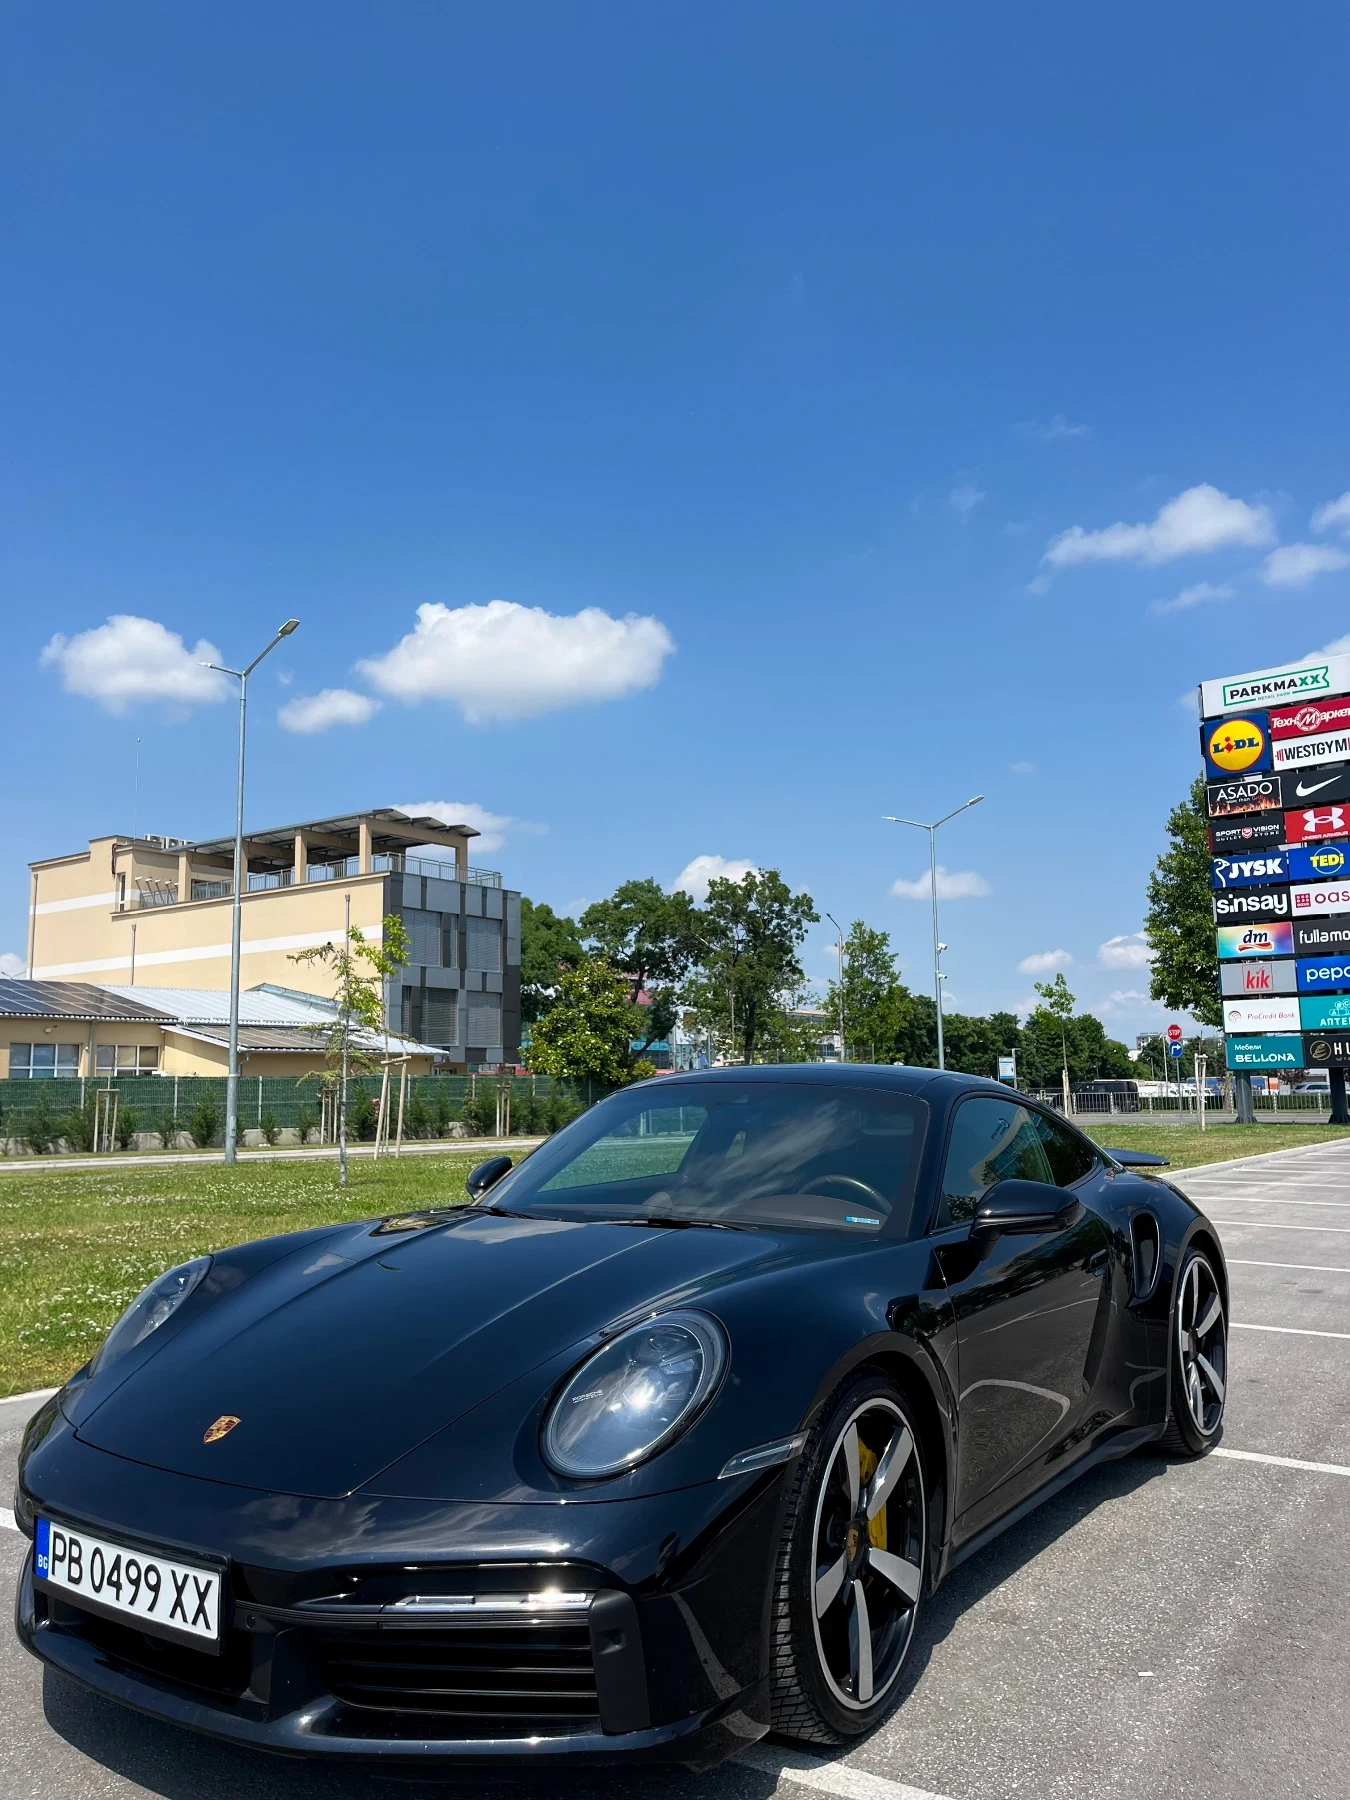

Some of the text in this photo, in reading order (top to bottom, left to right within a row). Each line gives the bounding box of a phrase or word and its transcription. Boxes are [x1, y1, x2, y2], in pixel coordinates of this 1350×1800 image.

[1230, 674, 1321, 700] PARKMAXX
[1284, 737, 1348, 761] WESTGYM
[1216, 781, 1273, 801] ASADO
[1215, 824, 1280, 837] SPORT VISION
[1322, 830, 1349, 838] ARMOUR
[1309, 853, 1345, 868] TEDi
[1228, 858, 1284, 879] JYSK
[1216, 893, 1288, 915] sinsay
[1243, 929, 1268, 944] dm
[1247, 1011, 1295, 1020] ProCredit Bank
[1320, 1017, 1350, 1027] АПТЕ
[1234, 1043, 1262, 1051] Мебели
[1234, 1052, 1296, 1063] BELLONA
[38, 1554, 48, 1570] BG
[90, 1546, 162, 1613] 0499
[169, 1568, 213, 1631] XX
